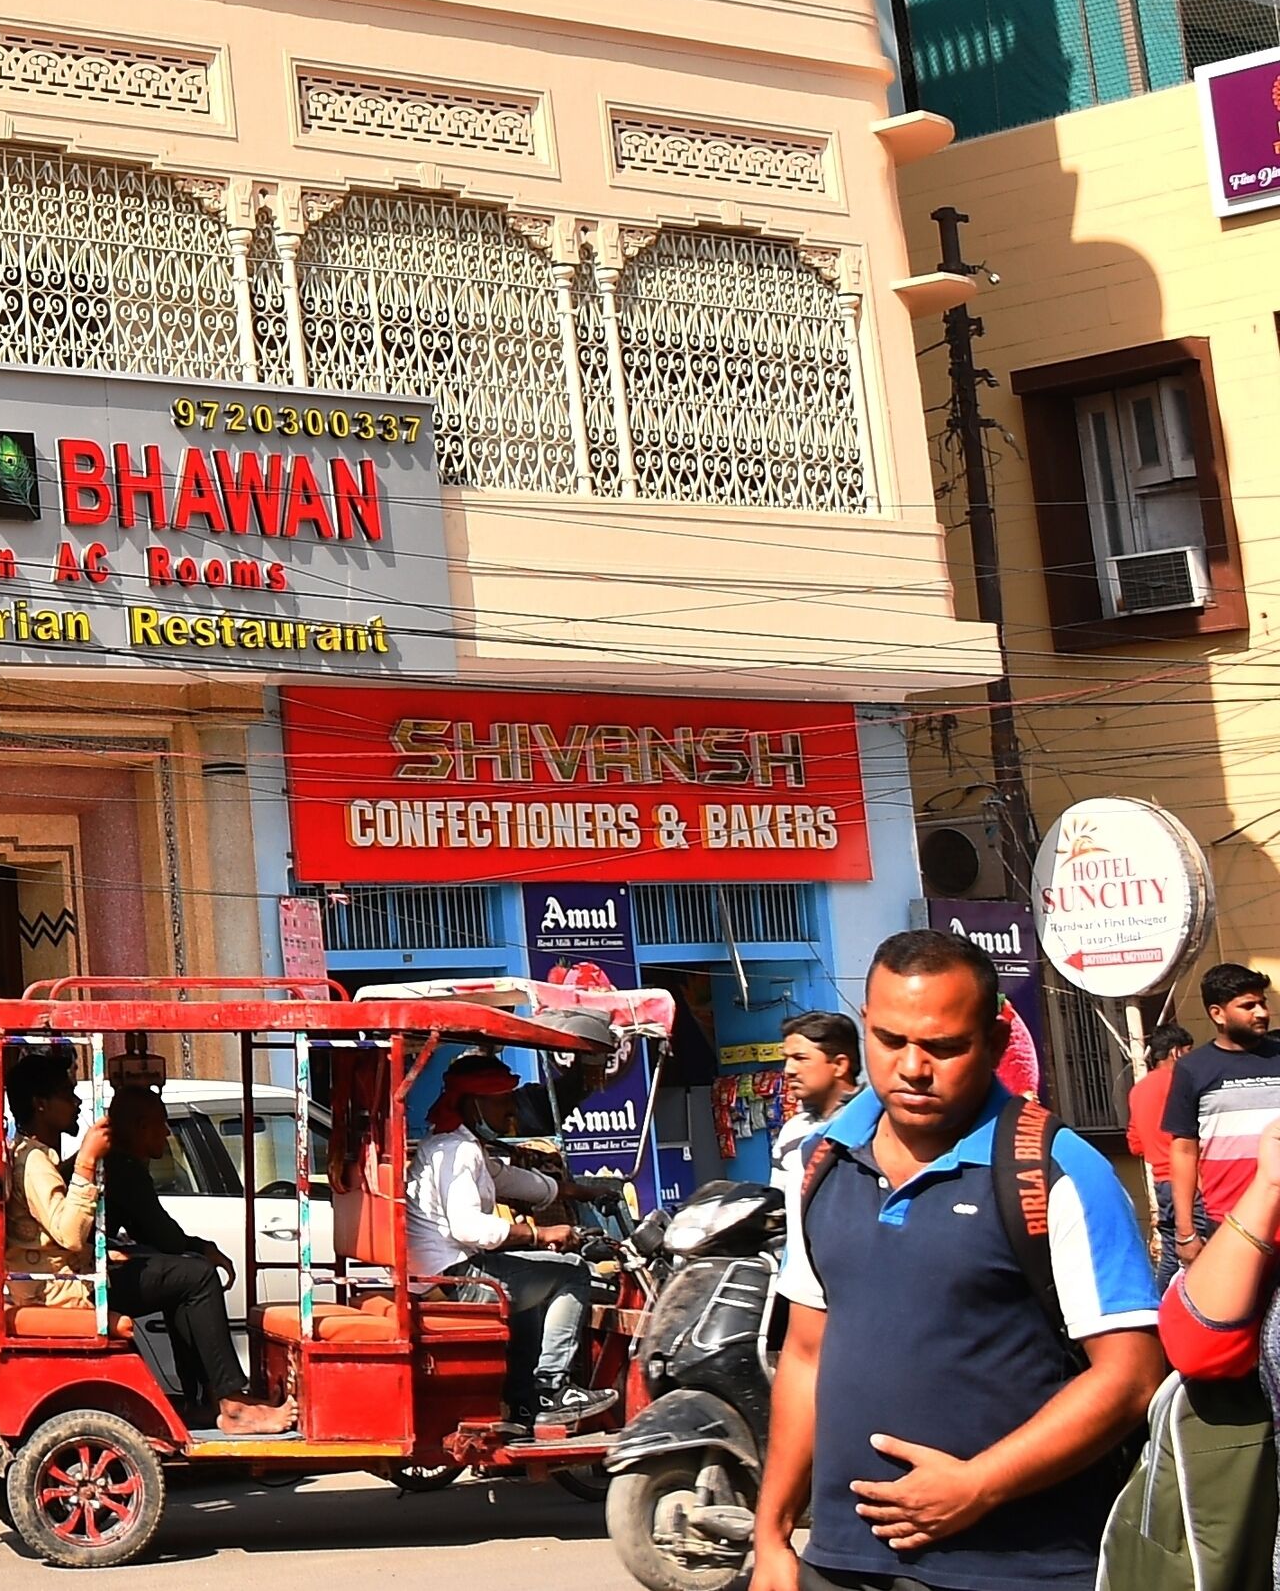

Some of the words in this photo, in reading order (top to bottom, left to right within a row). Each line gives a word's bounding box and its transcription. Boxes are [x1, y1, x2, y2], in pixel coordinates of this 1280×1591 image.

[172, 397, 421, 444] 9720300337
[56, 437, 382, 541] BHAWAN
[51, 541, 109, 583] AC
[144, 545, 288, 592] Rooms
[127, 605, 389, 654] Restaurant
[389, 717, 806, 788] SHIVANSH
[345, 798, 641, 851] CONFECTIONERS
[655, 802, 688, 850] &
[702, 805, 838, 851] BAKERS
[1072, 858, 1137, 881] HOTEL
[541, 896, 617, 933] Amul
[1042, 877, 1168, 914] SUNCITY
[1104, 918, 1125, 928] First
[562, 1100, 637, 1133] Amul
[1016, 1169, 1048, 1236] BIRLA
